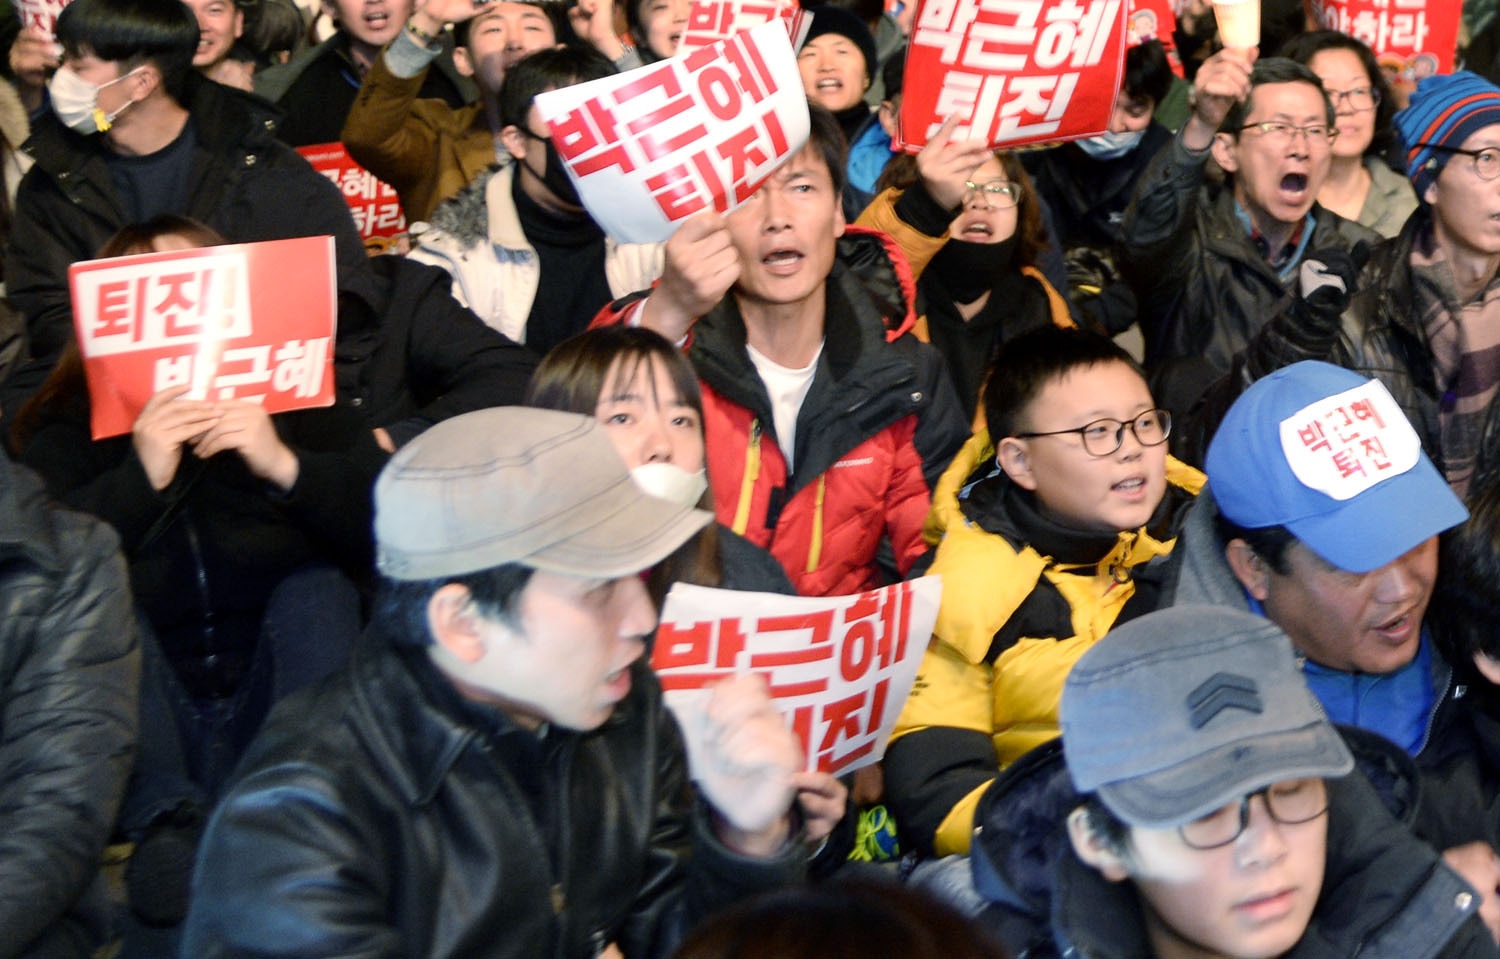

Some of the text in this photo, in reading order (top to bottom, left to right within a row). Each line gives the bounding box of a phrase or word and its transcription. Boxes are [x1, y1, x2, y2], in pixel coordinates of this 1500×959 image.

[547, 29, 779, 178] 박근혜
[925, 69, 1081, 143] 퇴진
[644, 108, 790, 222] 퇴진
[91, 264, 238, 344] 퇴진!
[1297, 397, 1387, 453] 박근혜
[1331, 435, 1393, 479] 퇴진
[651, 580, 913, 701] 박근혜
